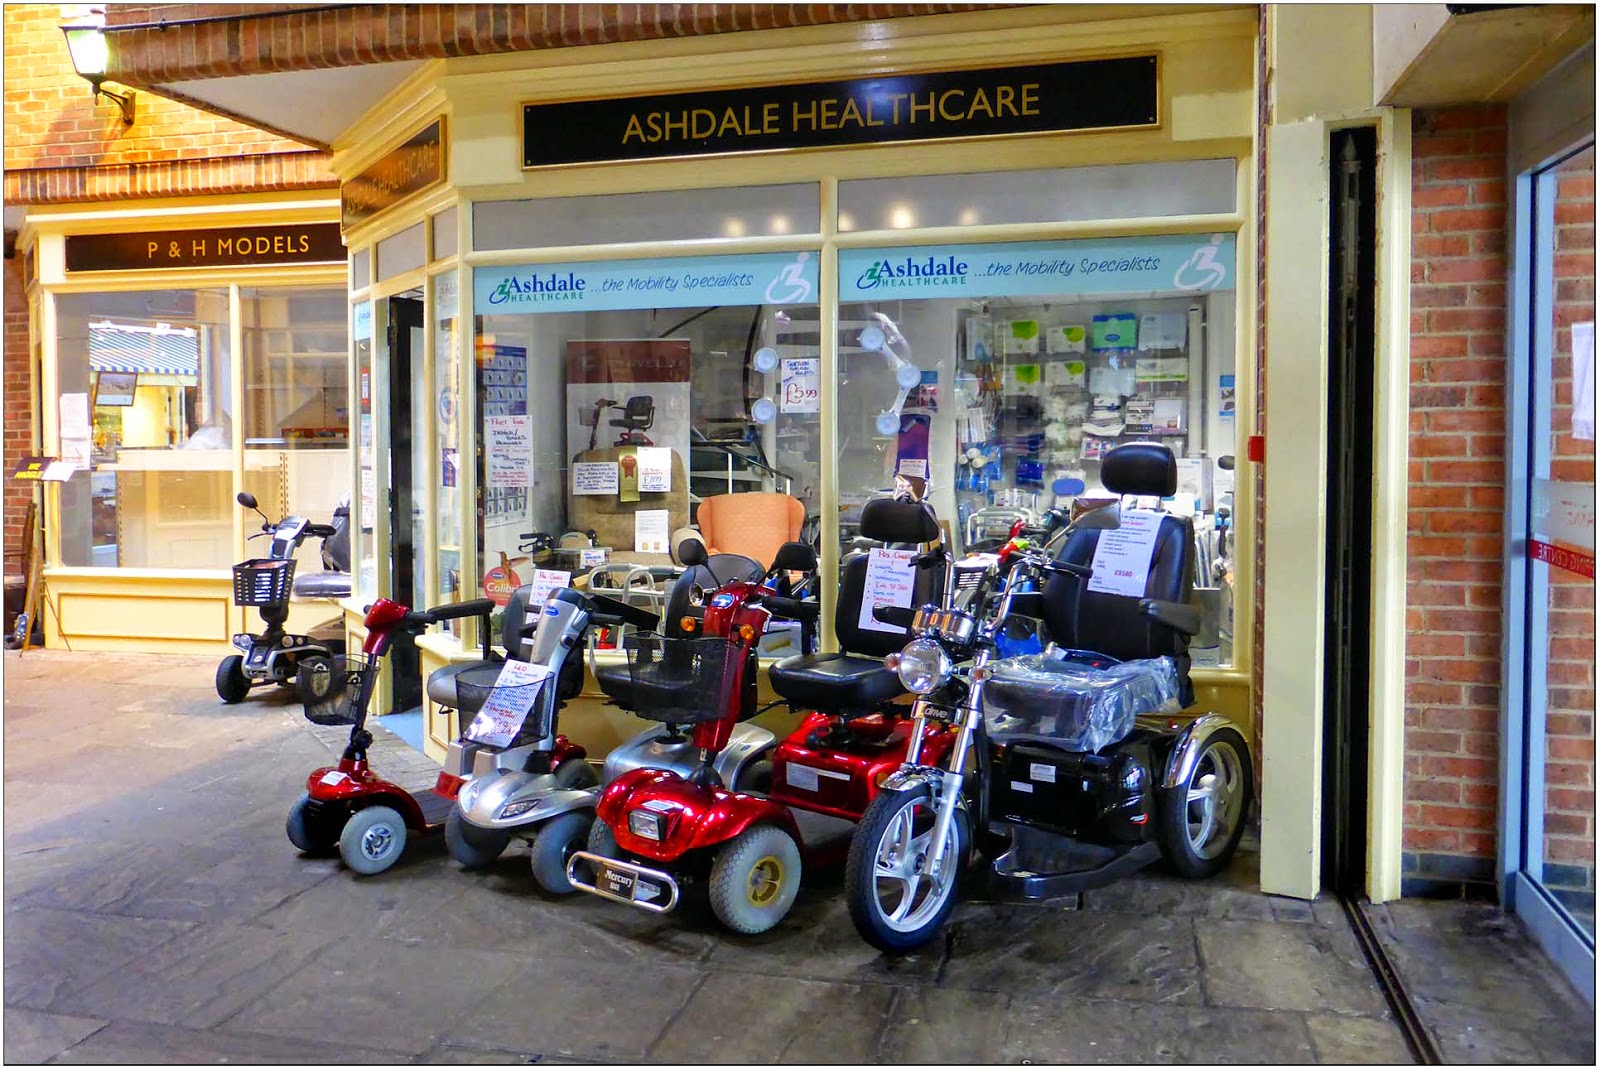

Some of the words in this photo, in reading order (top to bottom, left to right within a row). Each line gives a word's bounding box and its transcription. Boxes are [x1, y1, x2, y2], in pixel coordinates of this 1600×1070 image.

[621, 103, 780, 145] ASHDALE
[791, 83, 1041, 132] HEALTHCARE
[148, 242, 158, 259] P
[168, 241, 181, 258] &
[193, 240, 206, 257] H
[218, 235, 310, 256] MODELS
[877, 255, 968, 279] Ashdale
[1015, 259, 1075, 276] Mobility
[1079, 256, 1161, 273] Specialists
[507, 272, 586, 294] Ashdale
[627, 275, 679, 292] Mobility
[682, 272, 754, 290] Specialists
[881, 276, 967, 288] HEALTHCARE
[511, 291, 584, 302] HEALTHCARE
[924, 706, 948, 719] drive
[604, 869, 634, 888] Mercury
